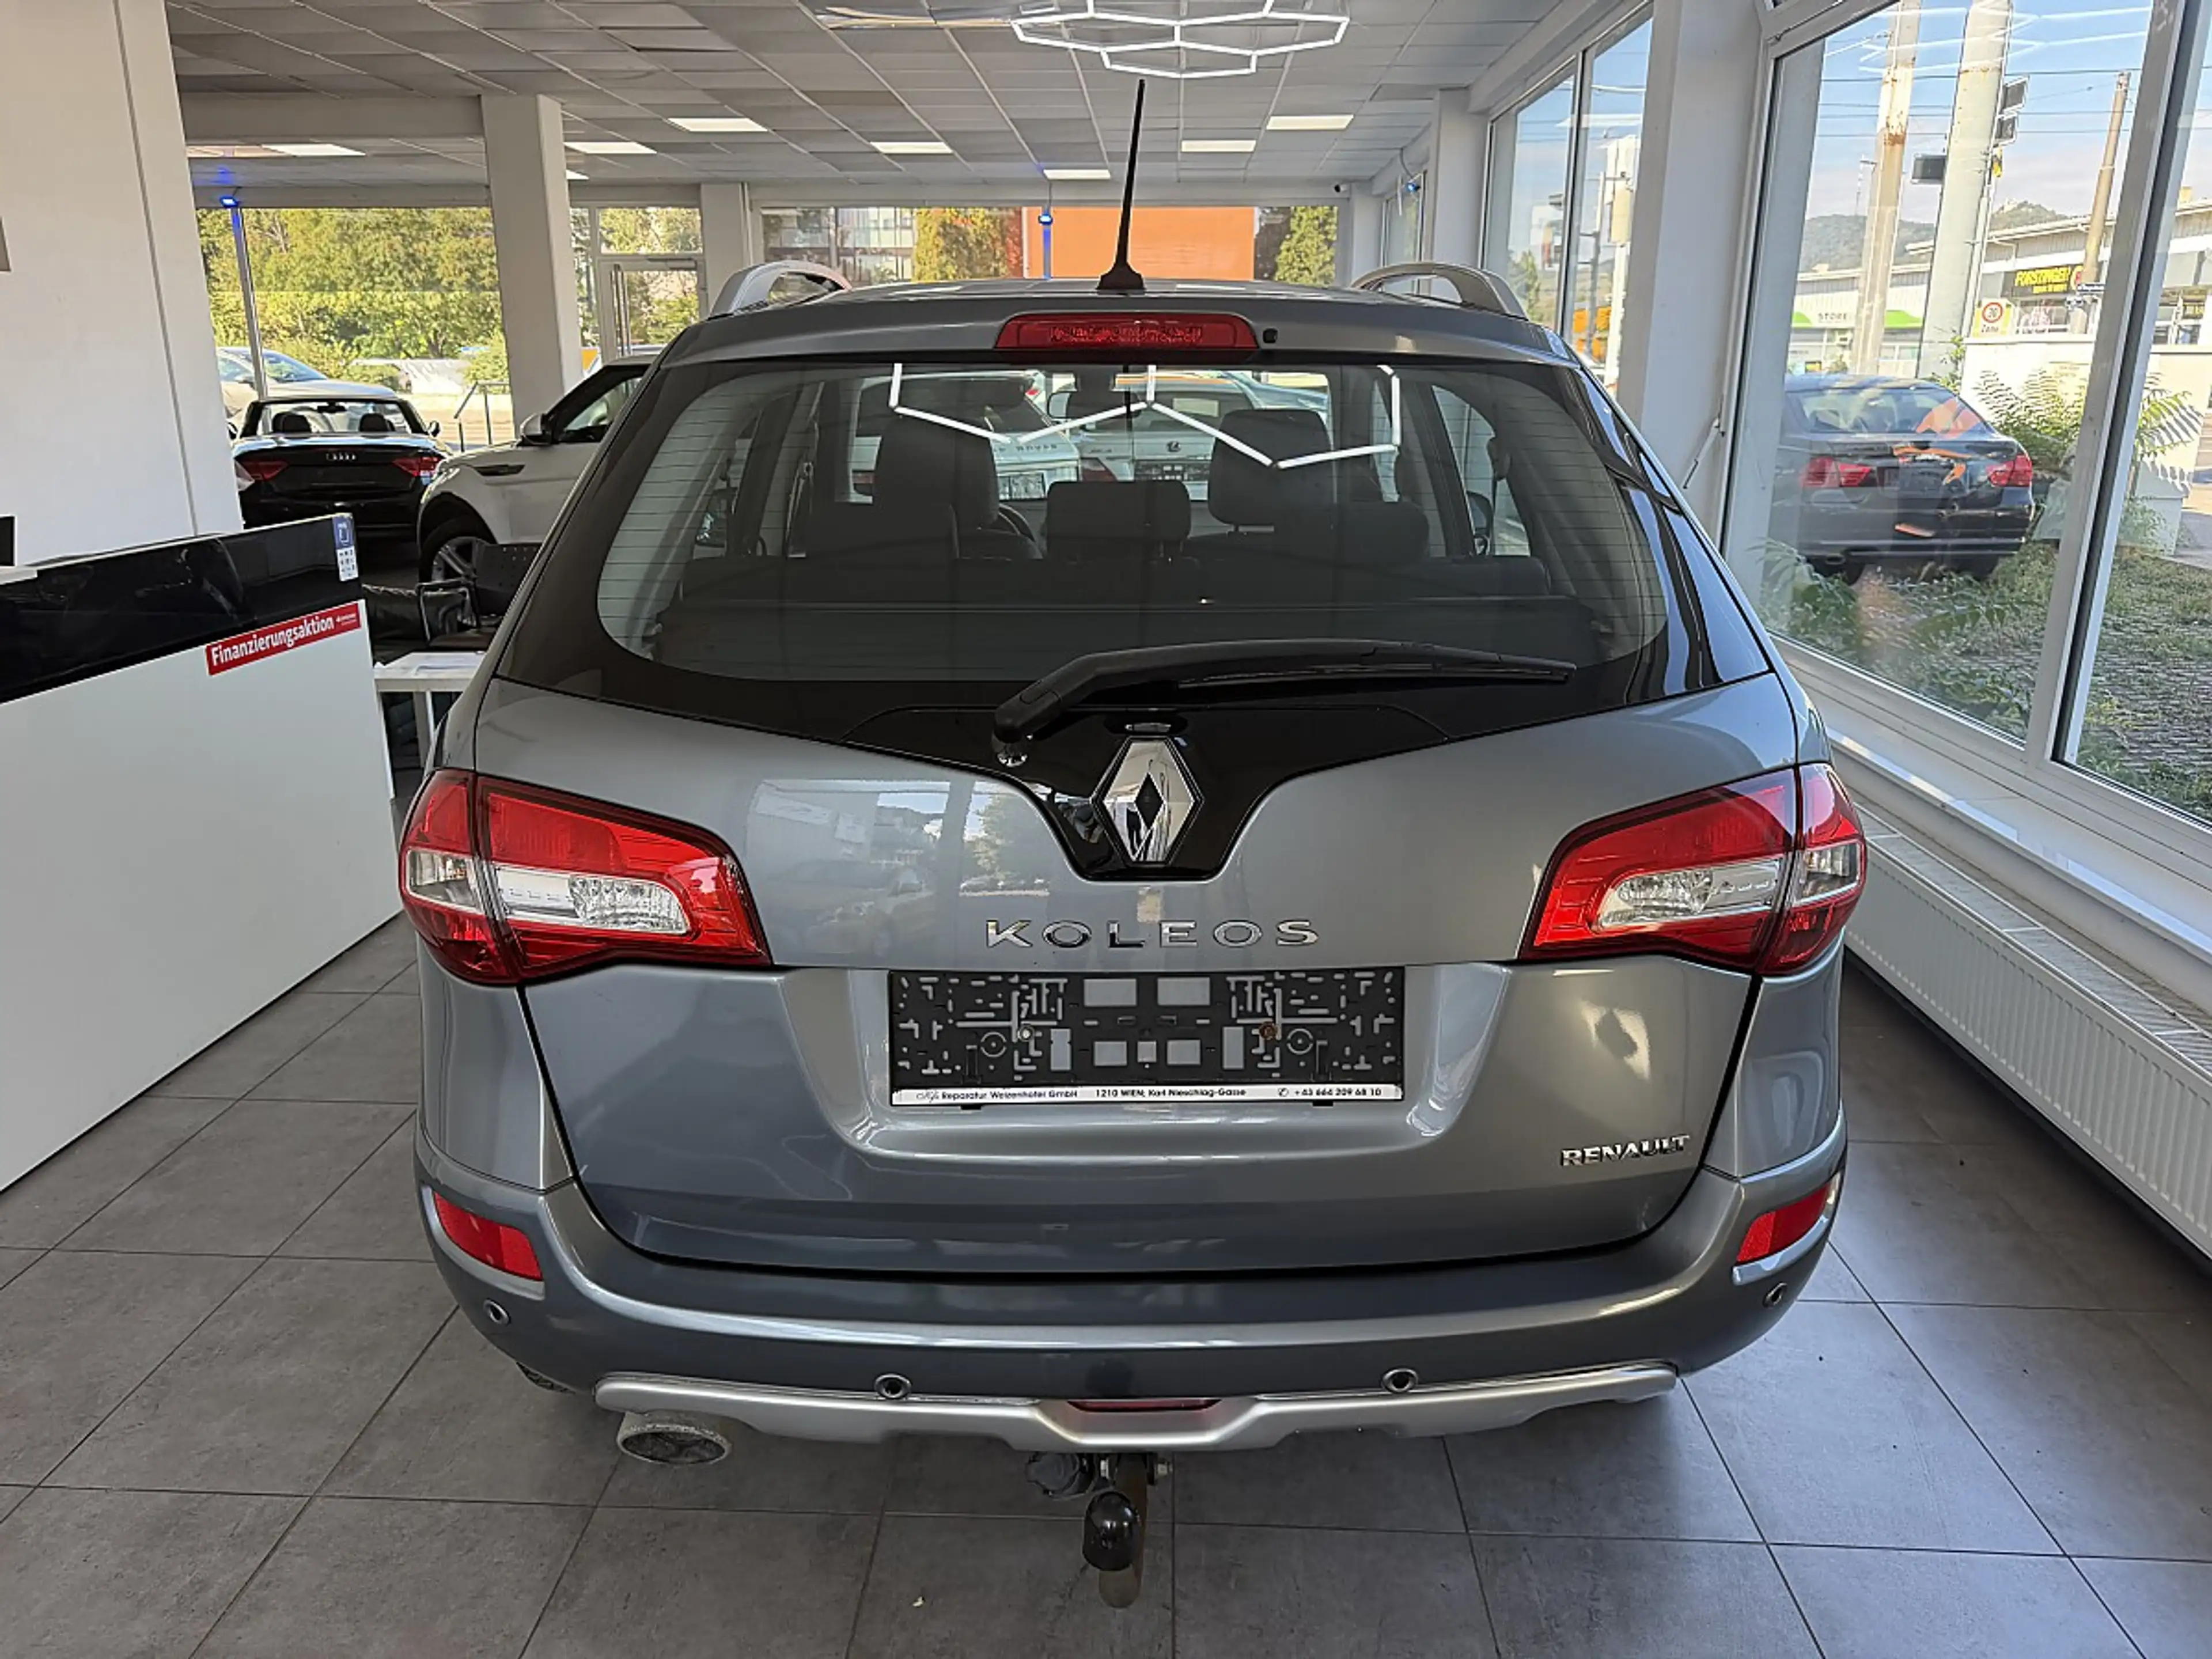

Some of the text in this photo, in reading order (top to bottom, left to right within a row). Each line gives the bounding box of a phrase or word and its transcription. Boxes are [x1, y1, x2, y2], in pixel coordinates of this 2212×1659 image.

[1982, 324, 1999, 332] Zone
[211, 615, 335, 666] Finanzierungsaktion
[986, 919, 1319, 948] KOLEOS
[941, 1091, 987, 1101] Reparatur
[1048, 1089, 1078, 1098] GmbH
[1096, 1089, 1118, 1097] 1210
[1370, 1087, 1381, 1096] 10
[1560, 1133, 1690, 1166] RENAULT
